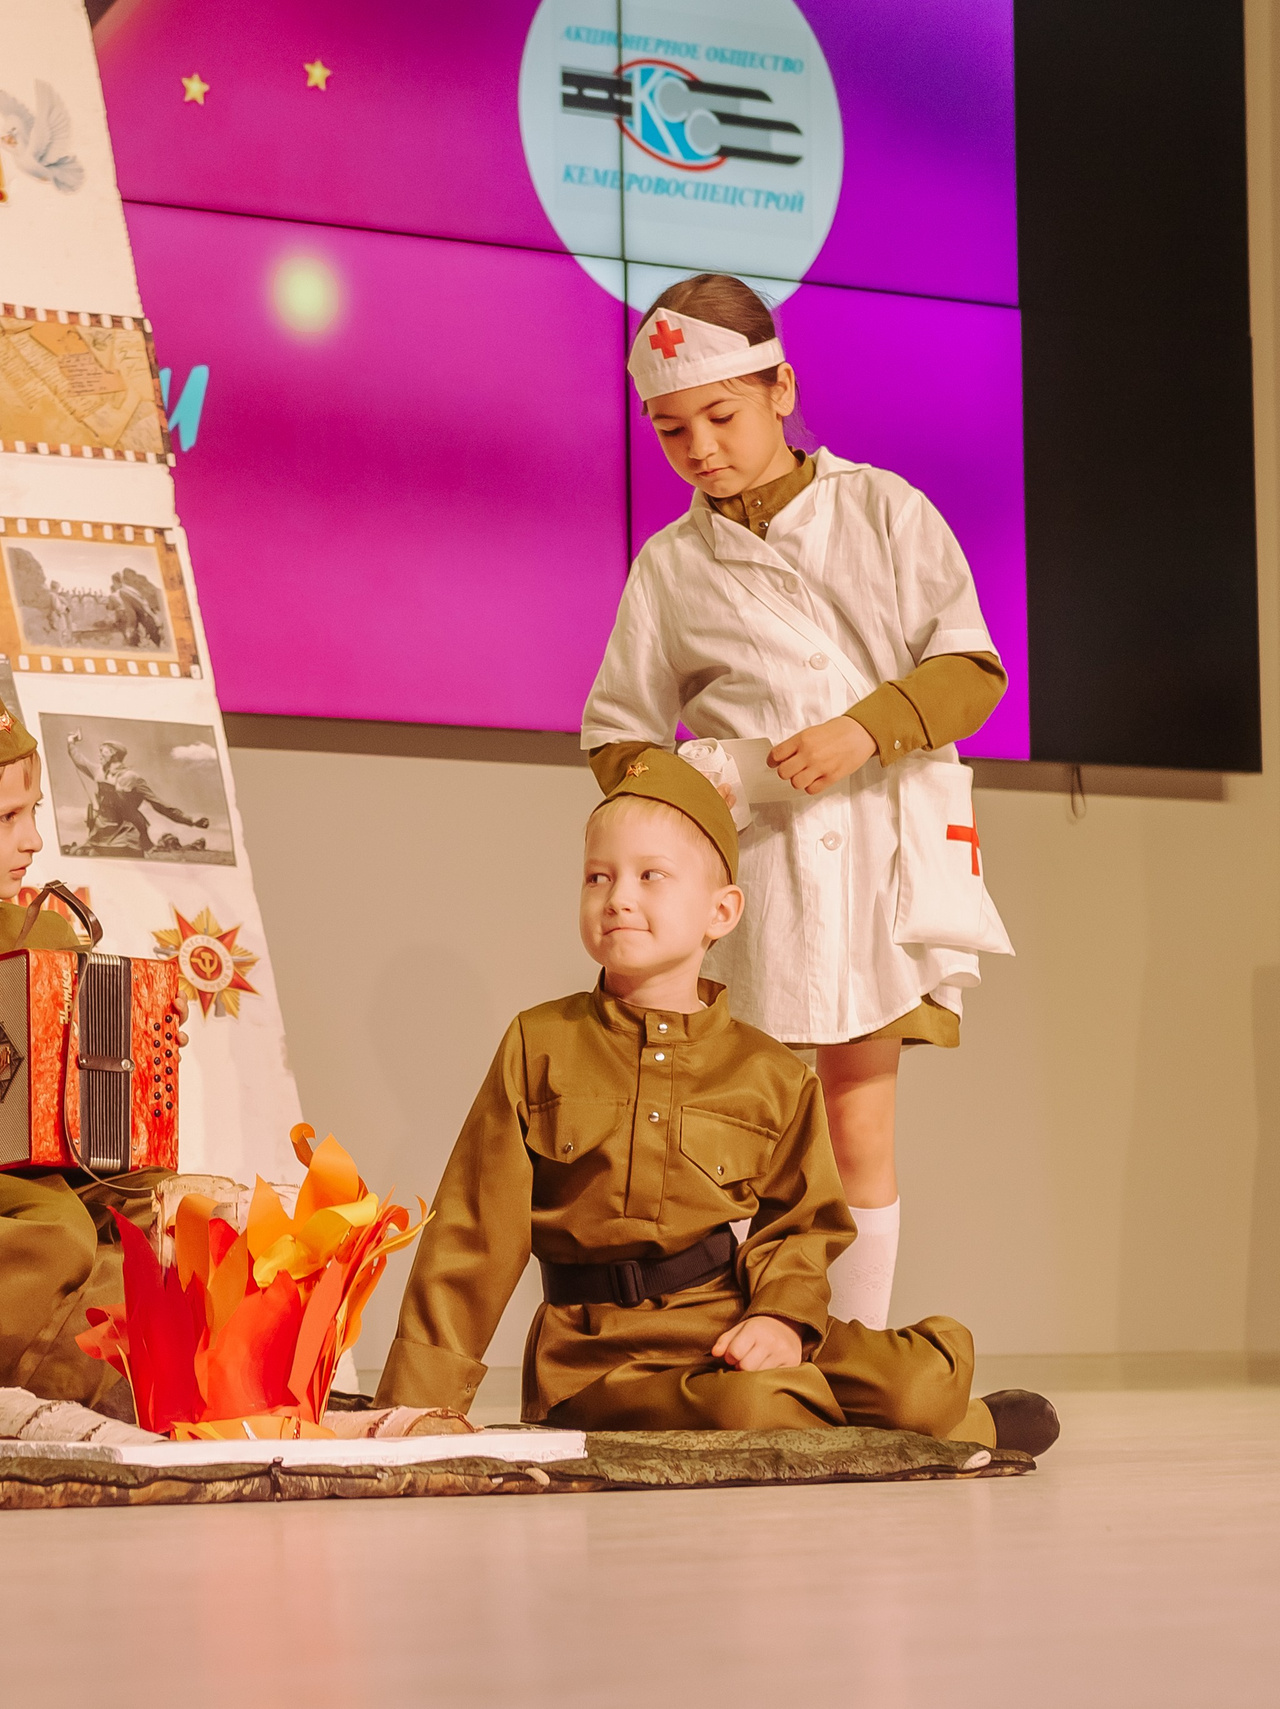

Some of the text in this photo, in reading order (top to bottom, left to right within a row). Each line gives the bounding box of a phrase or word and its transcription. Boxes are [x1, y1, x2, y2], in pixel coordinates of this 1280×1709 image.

[561, 26, 805, 75] АКЦИОНЕРНОЕ ОБЩЕСТВО
[562, 164, 806, 214] КЕМЕРОВОСПЕЦСТРОЙ
